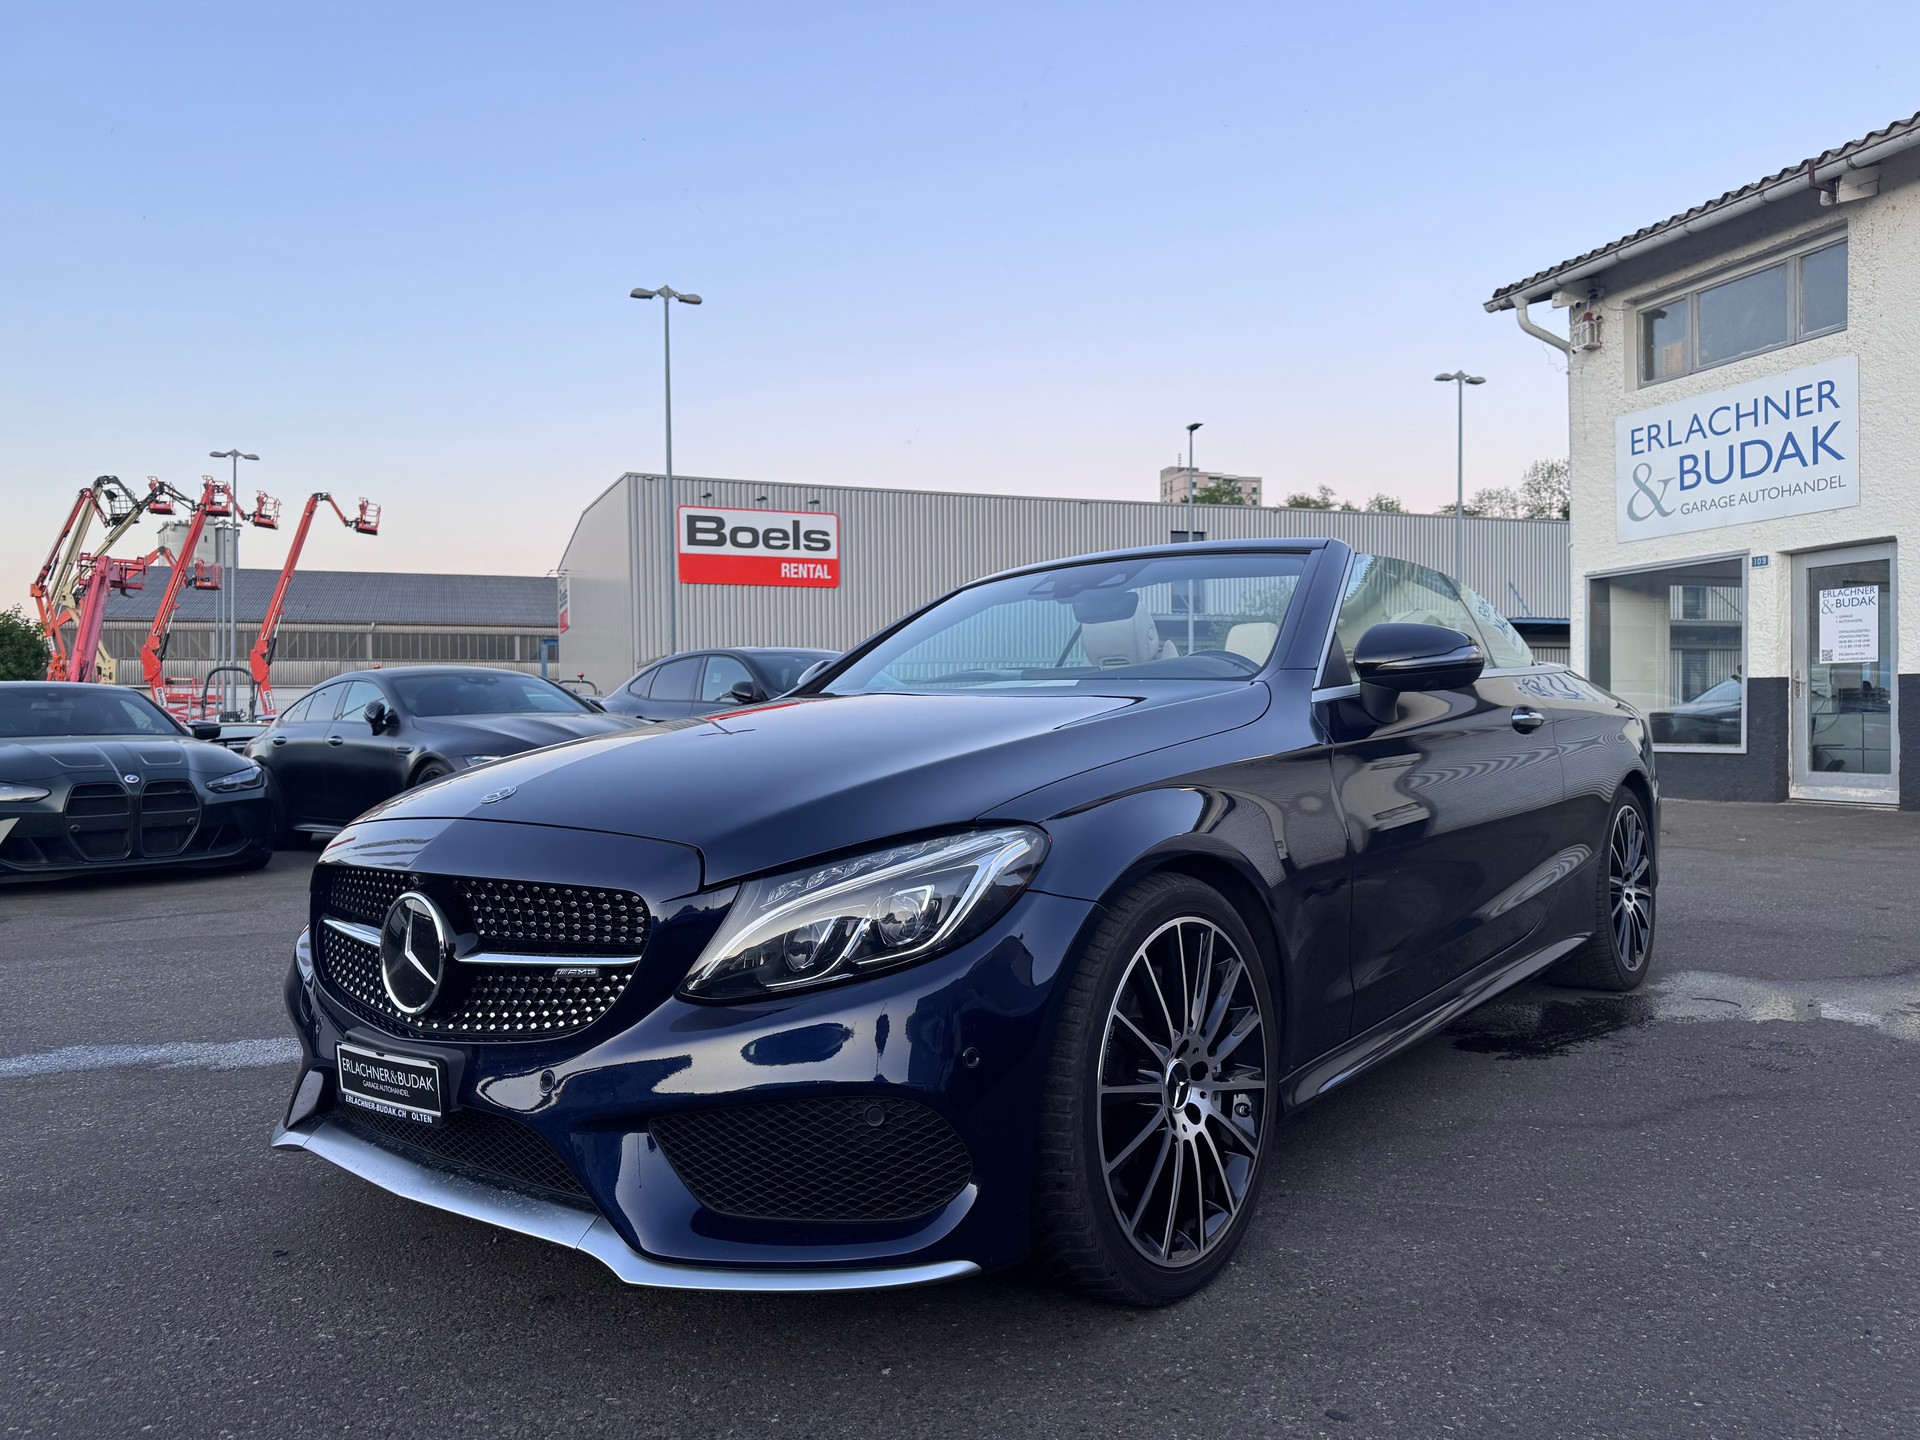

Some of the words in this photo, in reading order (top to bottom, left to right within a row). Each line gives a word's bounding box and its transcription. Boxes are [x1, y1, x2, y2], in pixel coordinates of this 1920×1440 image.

[1630, 379, 1841, 456] ERLACHNER
[1626, 462, 1677, 522] &
[1679, 420, 1846, 492] BUDAK
[1680, 494, 1736, 516] GARAGE
[1738, 475, 1847, 505] AUTOHANDEL
[686, 514, 831, 552] Boels
[780, 562, 832, 579] RENTAL
[1753, 556, 1767, 566] 109
[1821, 599, 1835, 615] &
[1835, 596, 1876, 608] BUDAK
[1822, 586, 1875, 599] ERLACHNER
[345, 1094, 407, 1118] ERLACHNER-BUDAK.CH
[411, 1111, 433, 1124] OLTEN
